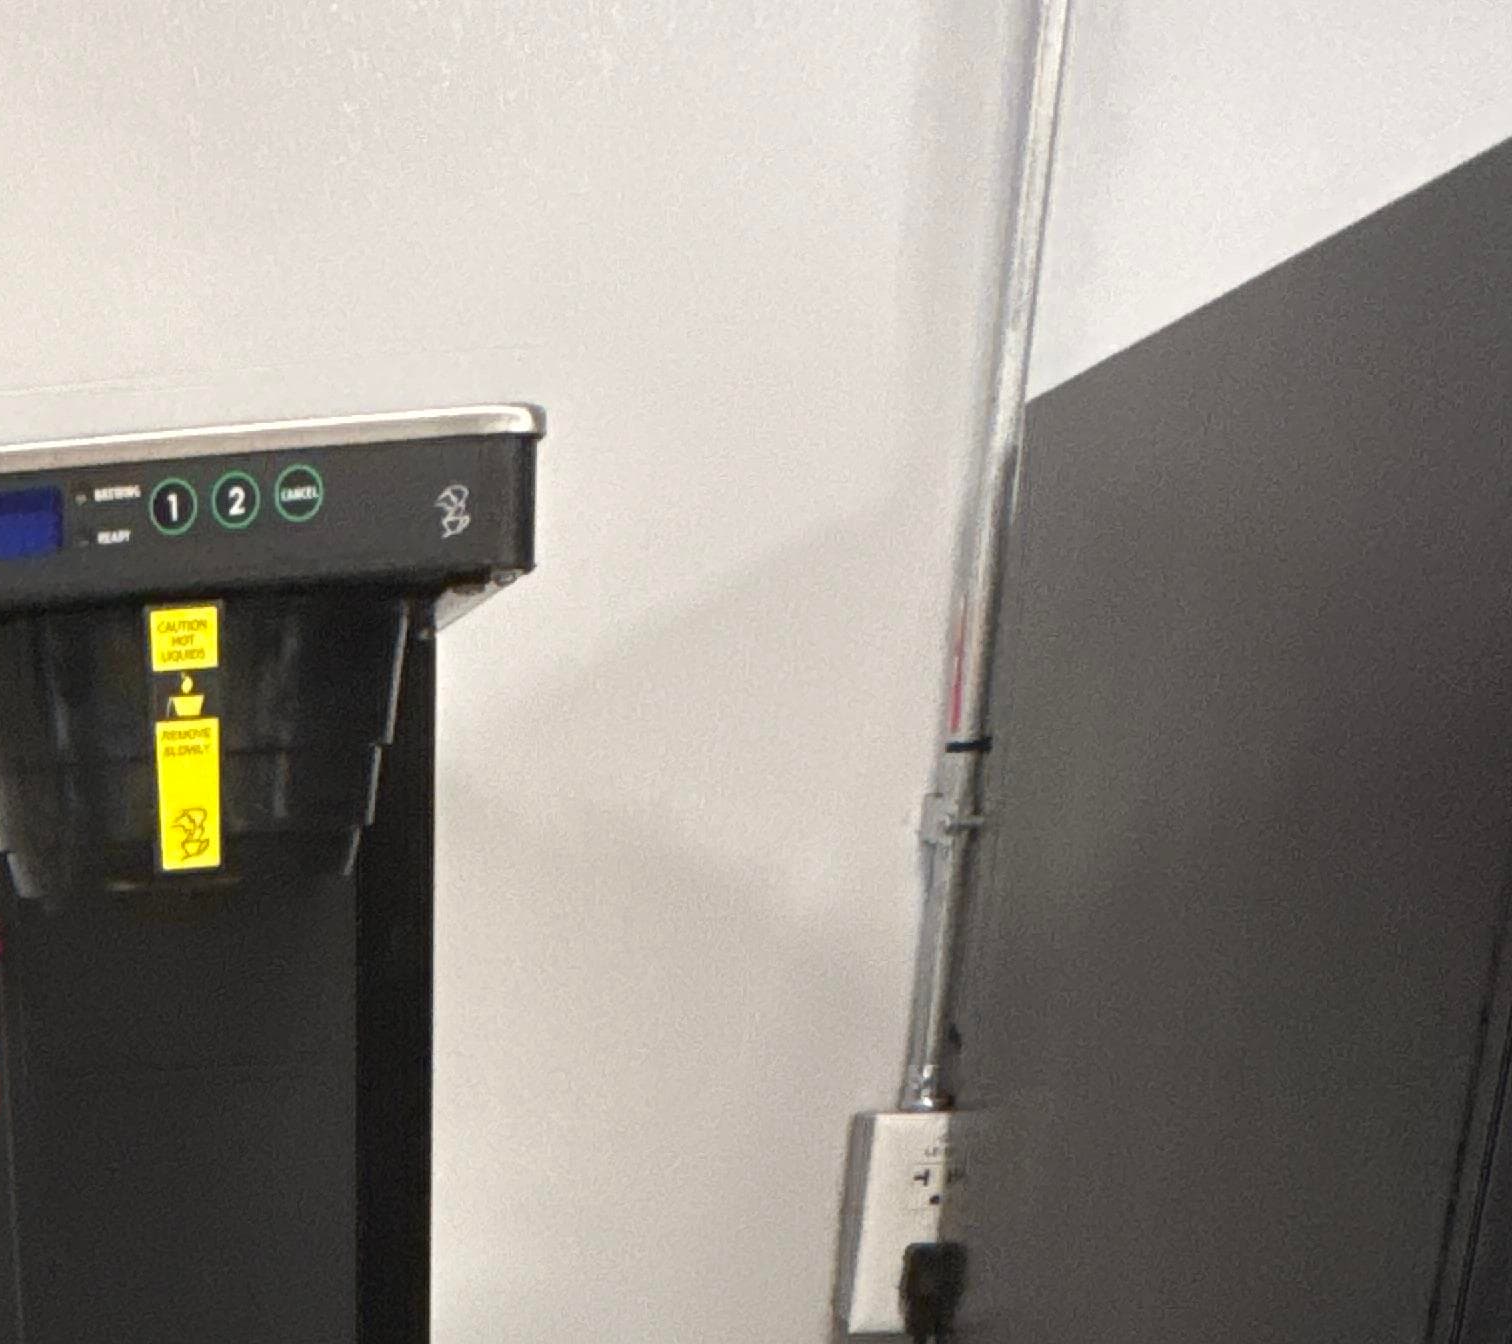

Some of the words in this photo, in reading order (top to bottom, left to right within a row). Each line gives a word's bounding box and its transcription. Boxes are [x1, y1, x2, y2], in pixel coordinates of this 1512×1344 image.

[280, 485, 319, 501] CANCEL
[166, 493, 178, 521] 1
[228, 486, 246, 516] 2
[157, 619, 207, 634] CAUTION
[172, 634, 194, 647] HOT
[161, 648, 206, 663] LIQUIDS
